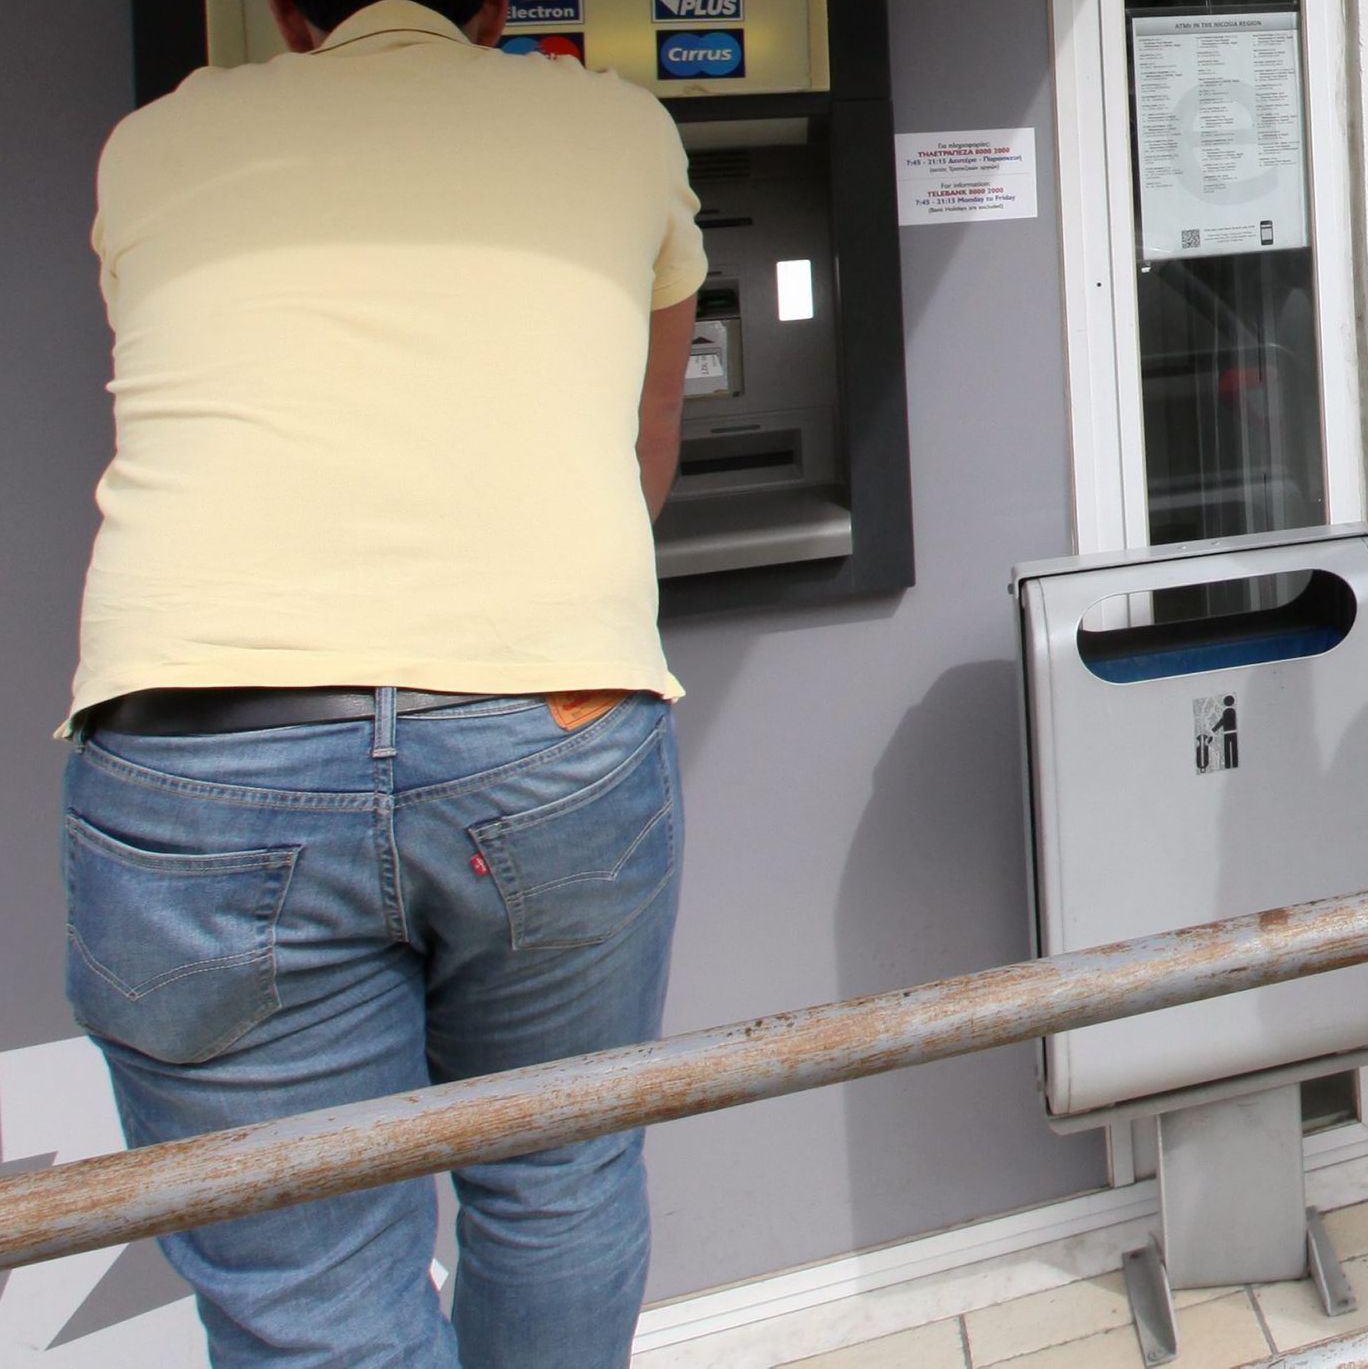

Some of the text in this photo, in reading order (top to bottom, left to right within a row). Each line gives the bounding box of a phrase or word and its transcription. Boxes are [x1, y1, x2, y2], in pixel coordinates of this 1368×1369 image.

[668, 47, 732, 63] Cirrus
[928, 189, 967, 198] TELEBANK
[957, 196, 984, 204] Monday
[995, 194, 1016, 202] Friday
